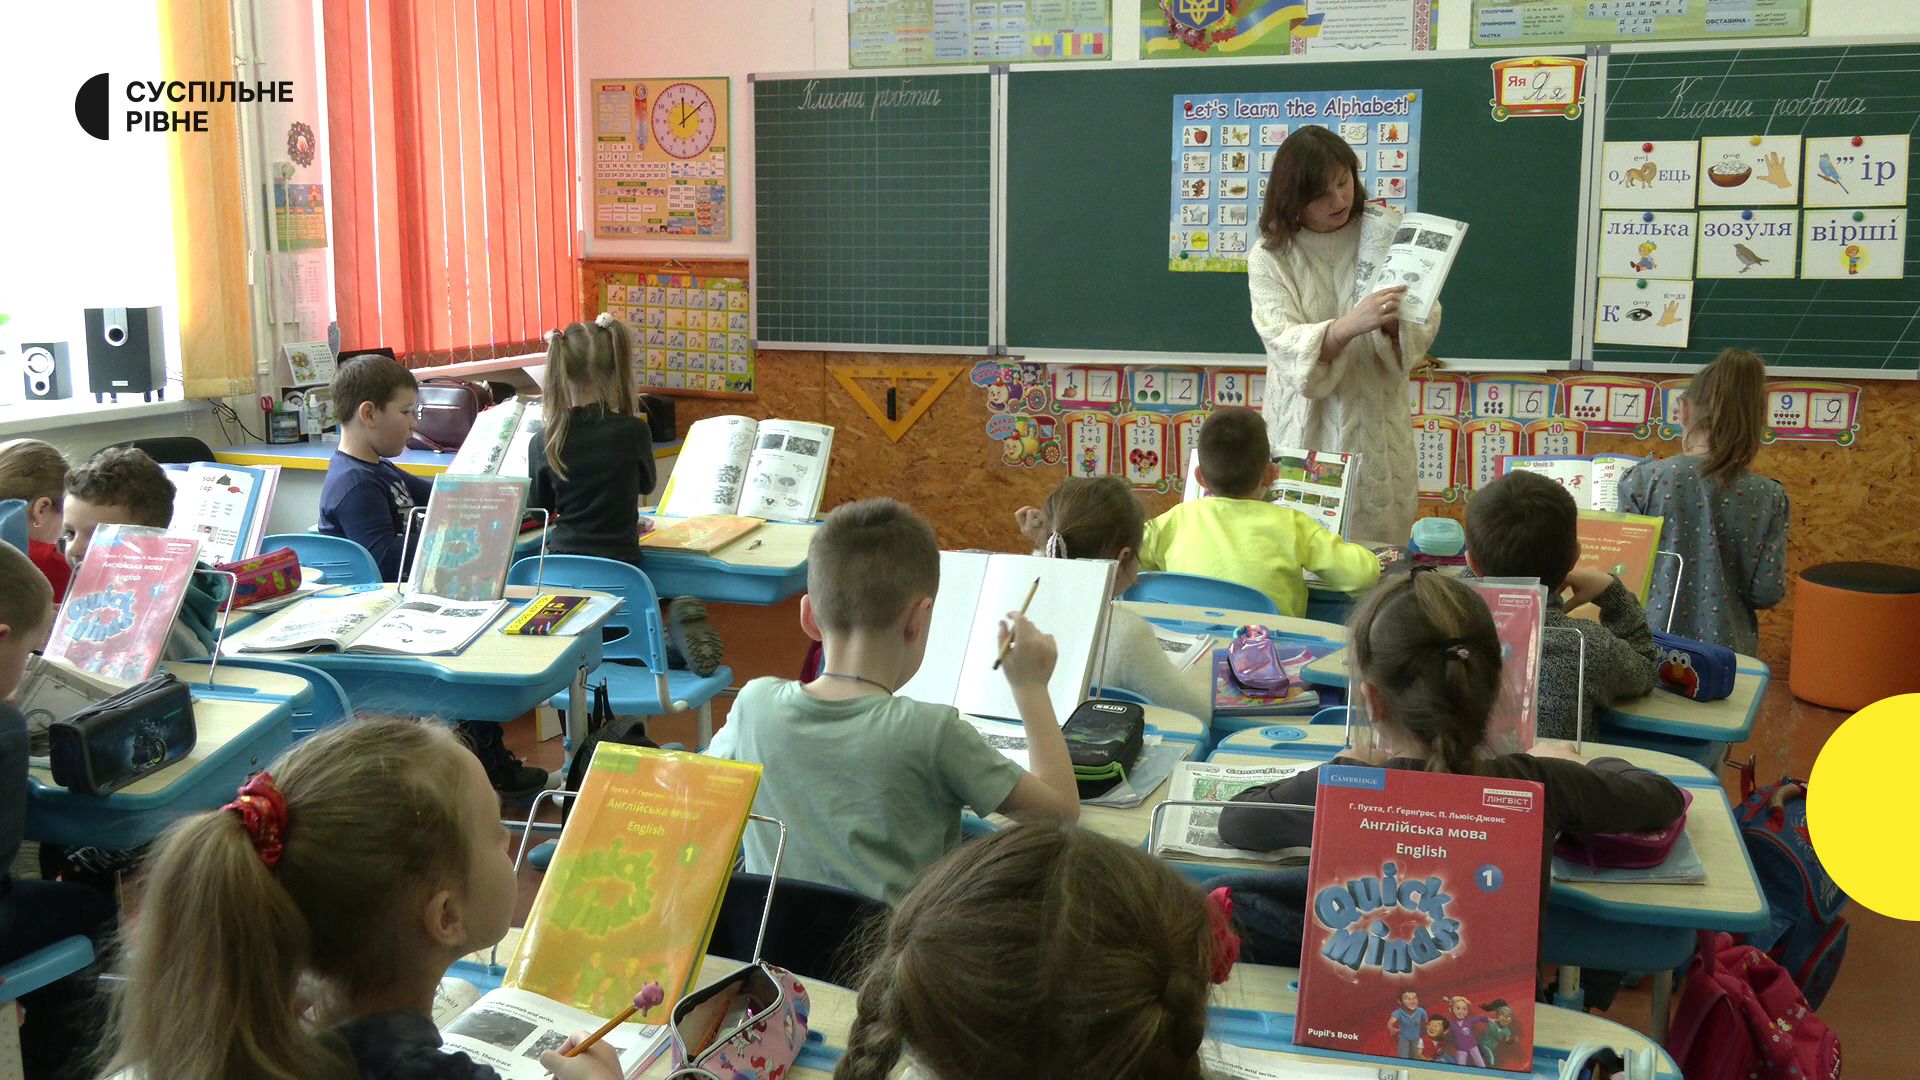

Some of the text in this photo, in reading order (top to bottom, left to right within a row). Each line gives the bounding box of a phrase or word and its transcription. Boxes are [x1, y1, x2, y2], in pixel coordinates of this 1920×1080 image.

[1706, 17, 1746, 25] ОБСТАВИНА
[1508, 75, 1526, 87] Яя
[797, 80, 942, 120] Класна робота
[1657, 76, 1867, 137] Класна робота
[1235, 100, 1279, 117] learn
[1287, 98, 1316, 116] the
[1324, 96, 1409, 120] Alphabet!
[1861, 154, 1896, 187] ір
[1066, 372, 1073, 385] 1
[1102, 375, 1112, 396] 1
[1144, 375, 1154, 389] 2
[1225, 376, 1235, 390] 3
[1178, 378, 1192, 400] 2
[1488, 386, 1499, 401] 6
[1583, 389, 1594, 404] 7
[1433, 387, 1451, 410] 5
[1525, 390, 1542, 413] 6
[1622, 393, 1639, 416] 7
[1780, 394, 1793, 410] 9
[1822, 399, 1842, 422] 9
[1087, 416, 1093, 424] 2
[1140, 417, 1146, 425] 3
[1195, 416, 1201, 424] 4
[1428, 421, 1435, 430] 8
[1490, 424, 1496, 433] 9
[1550, 424, 1562, 433] 10
[1420, 433, 1425, 441] 1
[1438, 433, 1443, 441] 7
[1437, 452, 1443, 460] 5
[1580, 553, 1600, 561] glish
[115, 573, 141, 583] English
[1330, 774, 1378, 786] CAMBRIDGE
[607, 798, 668, 817] Англійська
[1486, 795, 1529, 806] ЛІНГВІСТ
[1358, 803, 1385, 814] Пухта,
[1439, 810, 1447, 819] П.
[627, 820, 665, 836] English
[1359, 818, 1488, 840] Англійська мова
[684, 847, 693, 862] 1
[1396, 842, 1447, 859] English
[1482, 869, 1493, 887] 1
[1314, 862, 1453, 930] Quick
[1320, 915, 1462, 975] Minds
[527, 1009, 539, 1018] and
[1307, 1027, 1359, 1042] Pupil's Book
[481, 1052, 496, 1062] Then
